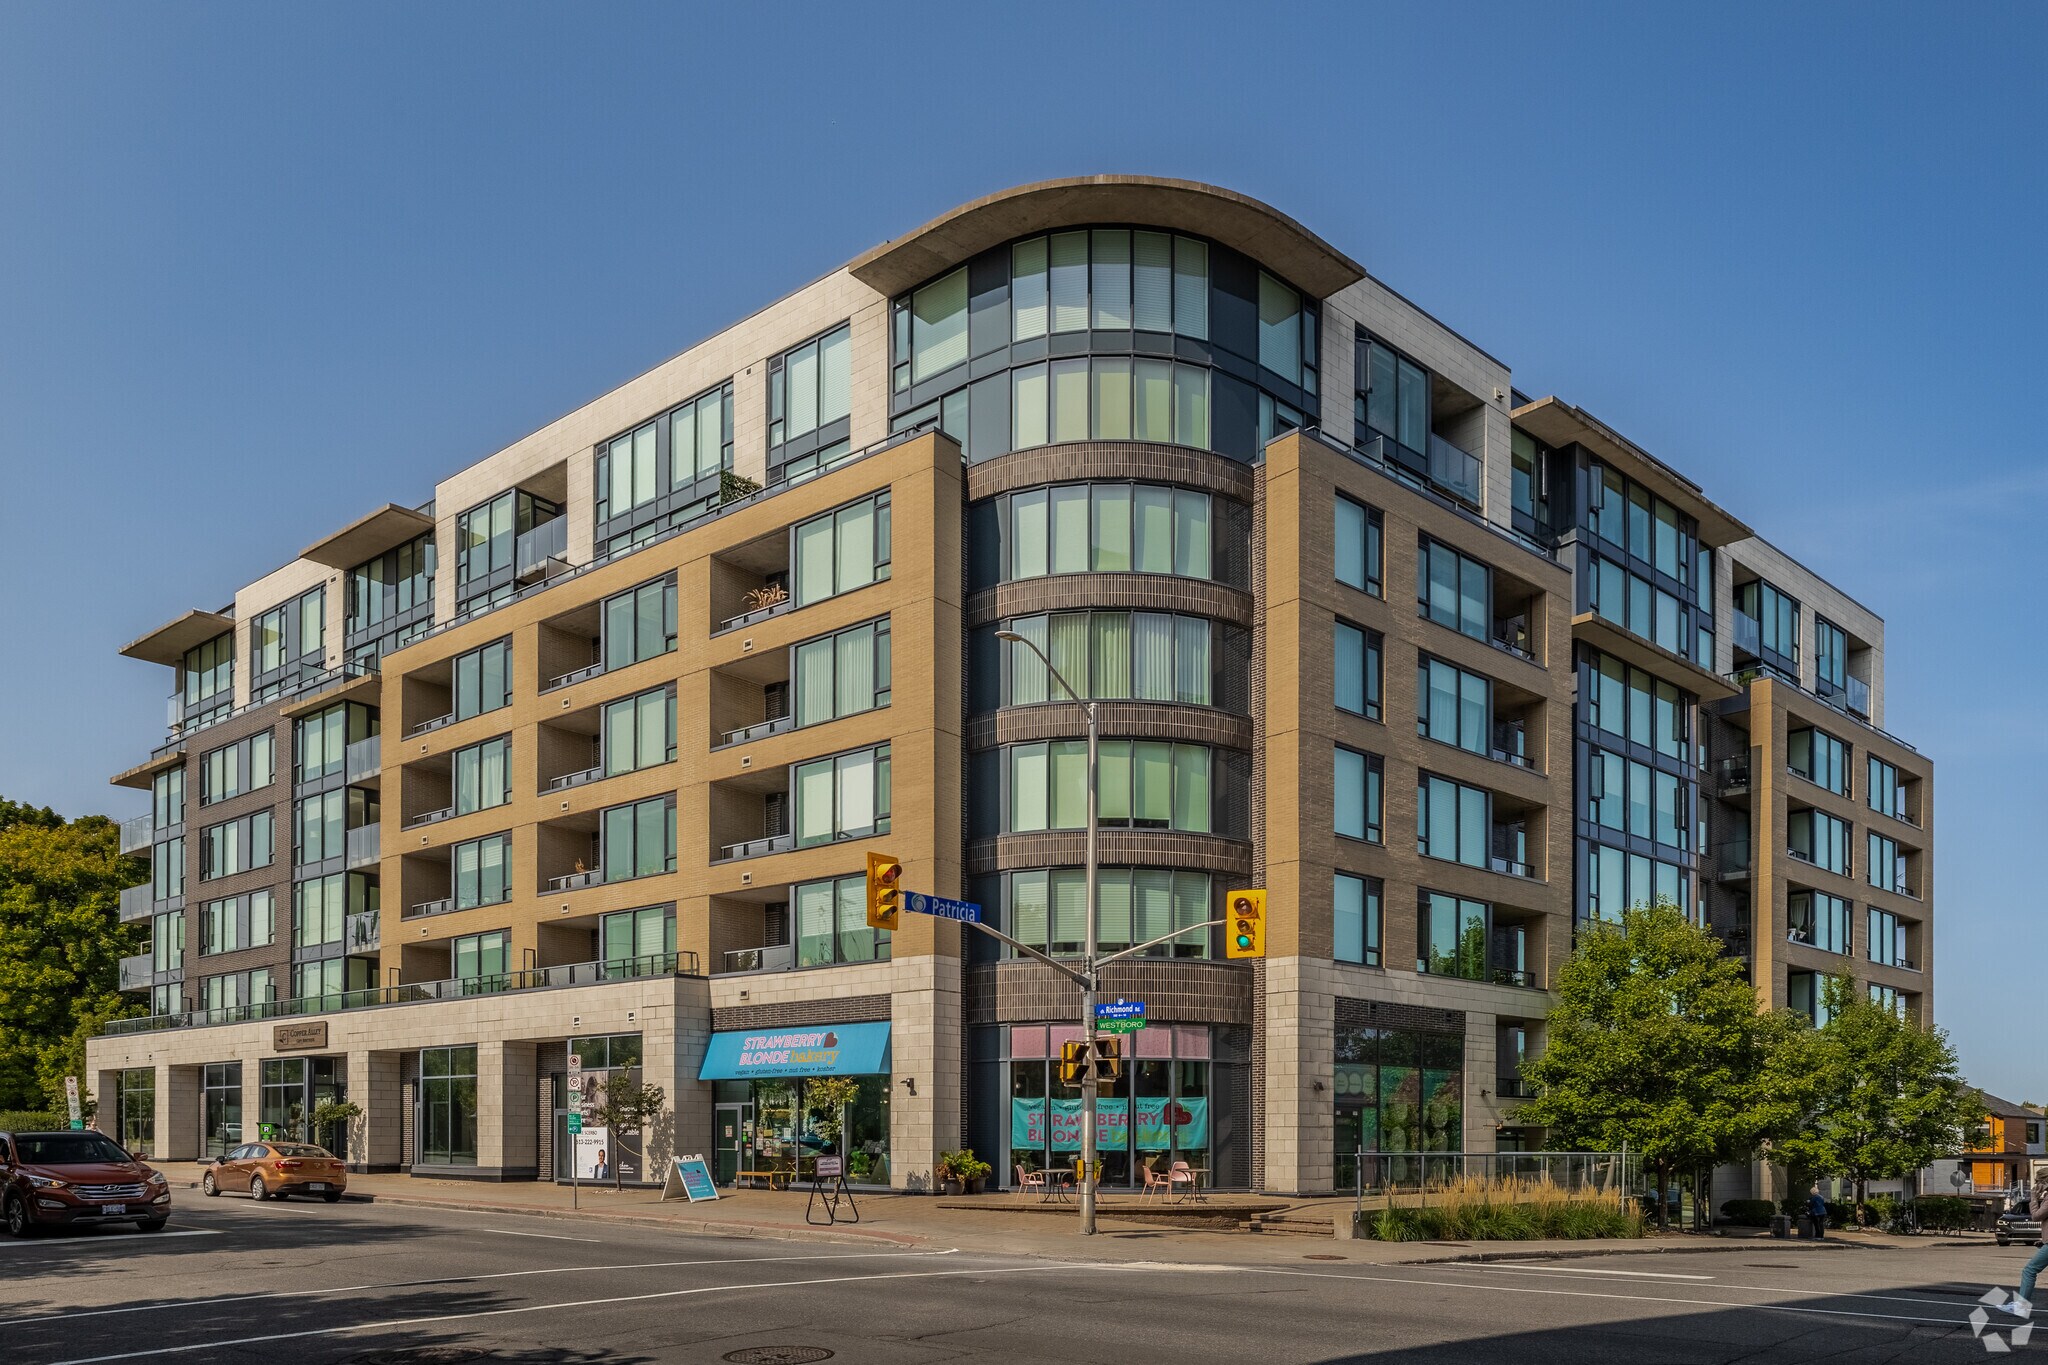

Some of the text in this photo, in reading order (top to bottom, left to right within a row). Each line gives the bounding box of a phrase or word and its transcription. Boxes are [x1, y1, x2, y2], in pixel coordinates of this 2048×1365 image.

[932, 898, 975, 921] Patricia
[1106, 1004, 1133, 1013] Richmond
[1100, 1021, 1143, 1029] WESTBORO
[743, 1032, 826, 1051] STRAWBERRY
[739, 1049, 840, 1066] BLONDE bakery
[1027, 1129, 1109, 1143] BLONE
